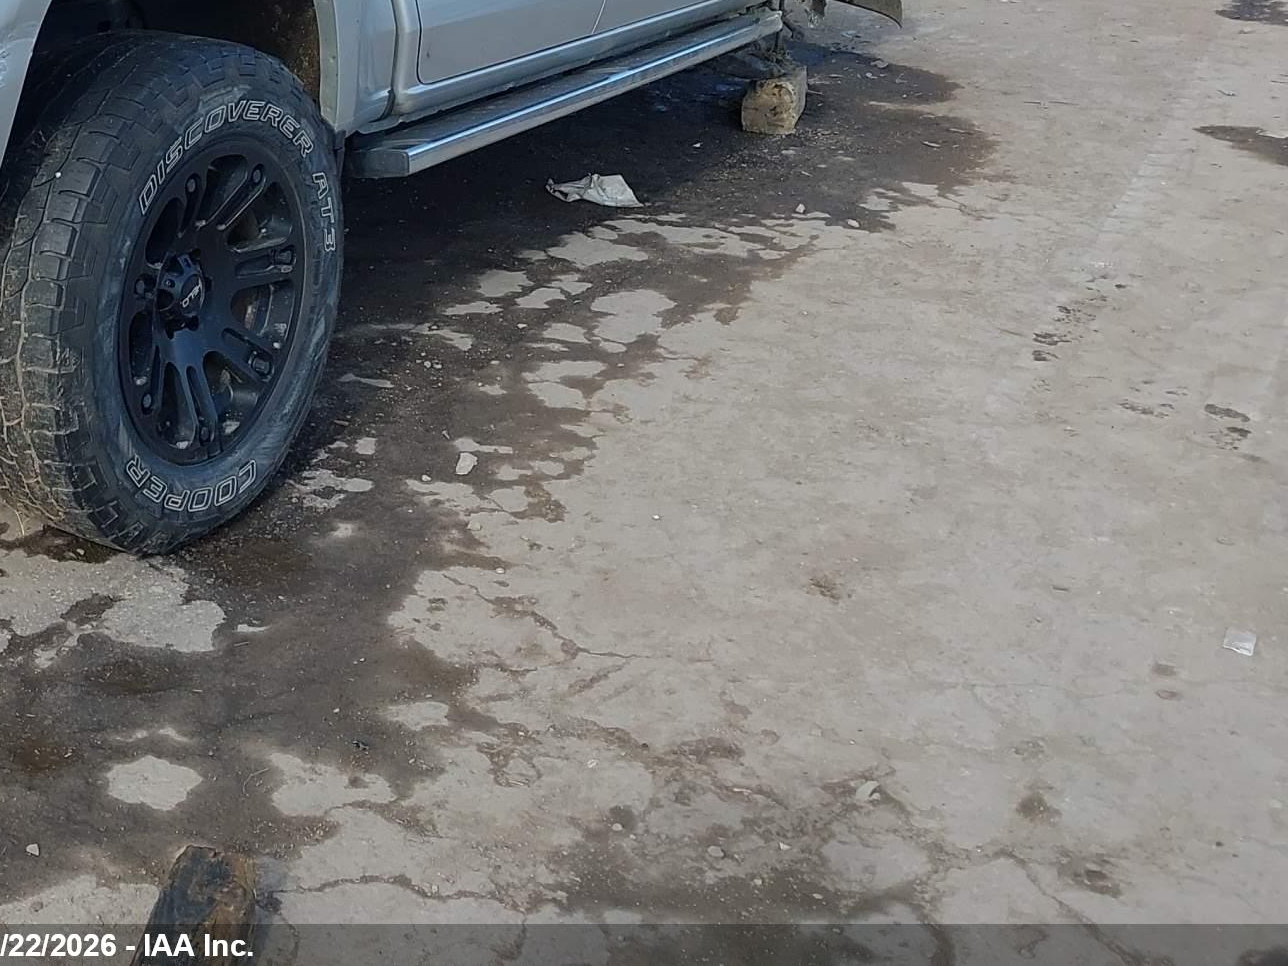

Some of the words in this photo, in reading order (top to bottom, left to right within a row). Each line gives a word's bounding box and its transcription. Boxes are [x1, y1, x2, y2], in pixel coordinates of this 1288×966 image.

[138, 99, 314, 216] DISCOVERER
[311, 171, 337, 253] AT3
[125, 454, 258, 514] COOPER
